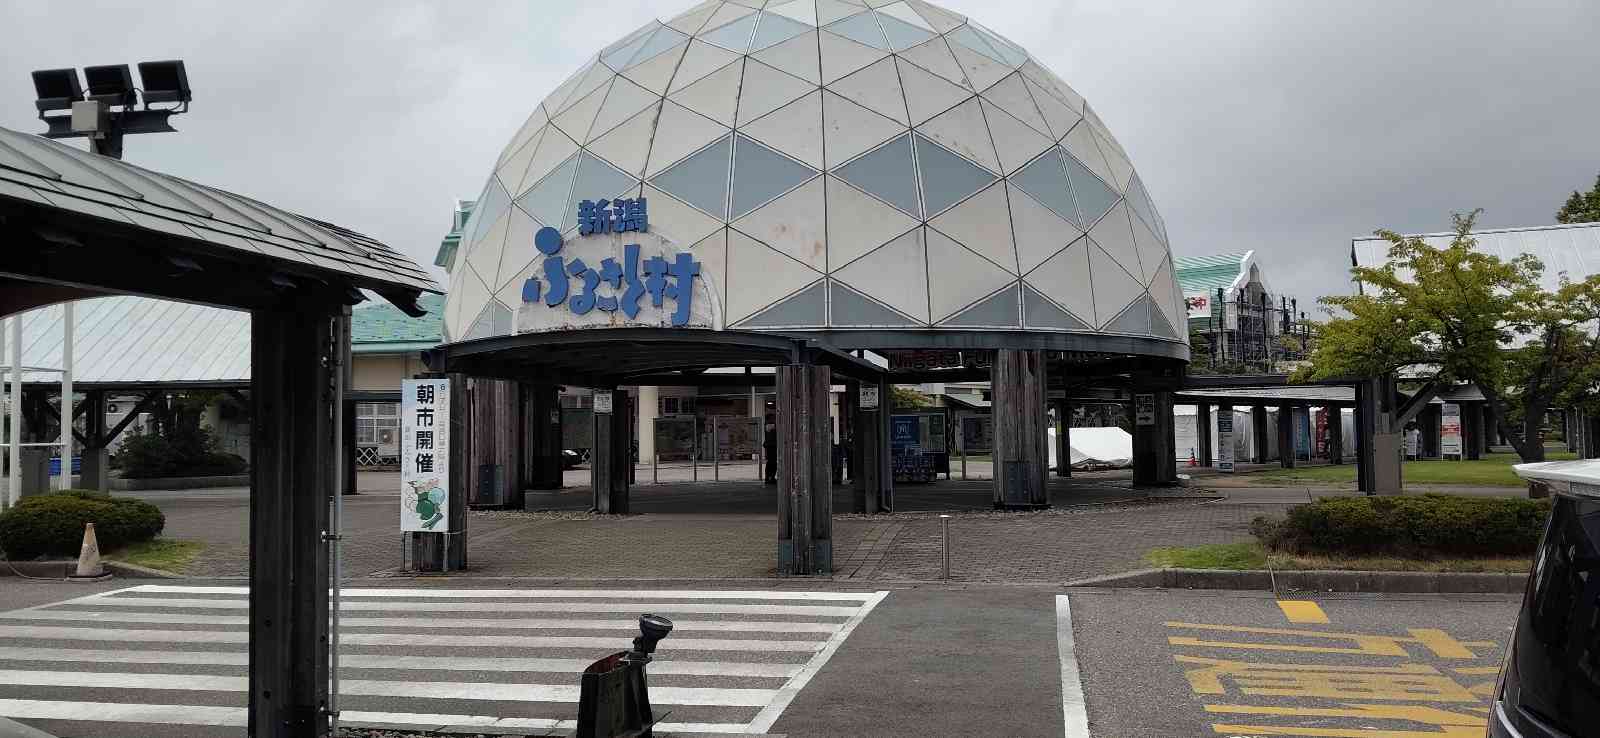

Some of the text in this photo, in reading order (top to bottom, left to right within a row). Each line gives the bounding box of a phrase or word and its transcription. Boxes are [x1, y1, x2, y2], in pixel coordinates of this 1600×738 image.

[578, 198, 649, 235] 新潟
[522, 227, 701, 326] ふるさと村
[416, 384, 434, 473] 朝市開催
